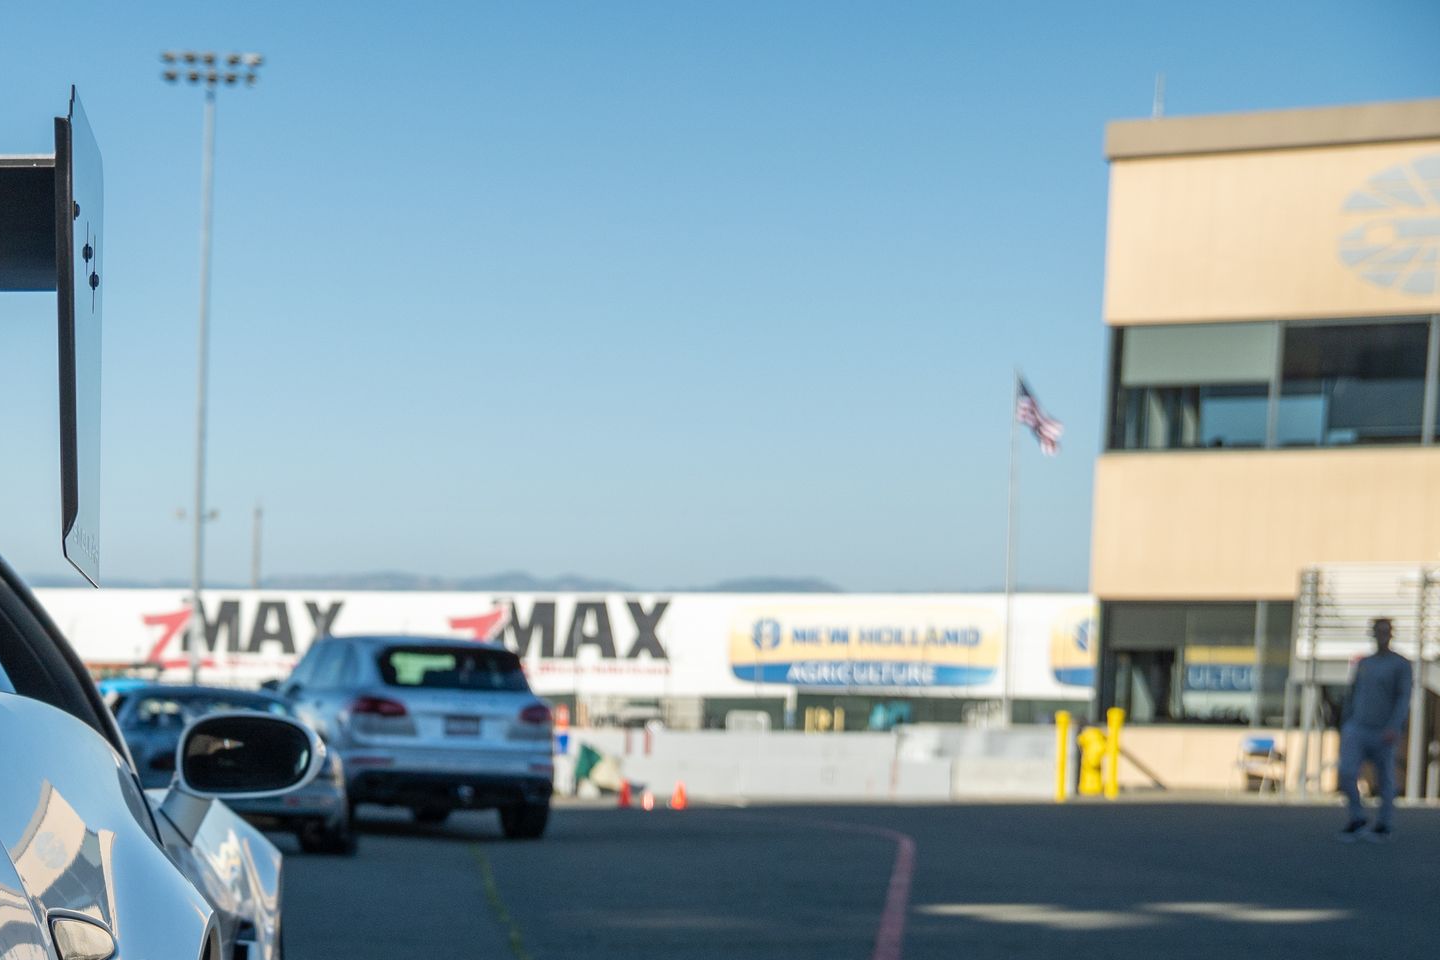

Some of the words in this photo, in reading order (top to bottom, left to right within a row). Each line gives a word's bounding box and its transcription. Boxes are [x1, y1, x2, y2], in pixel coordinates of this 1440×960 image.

[791, 625, 850, 646] NEW
[858, 625, 982, 647] HOLLAND
[786, 662, 936, 685] AGRICULTURE
